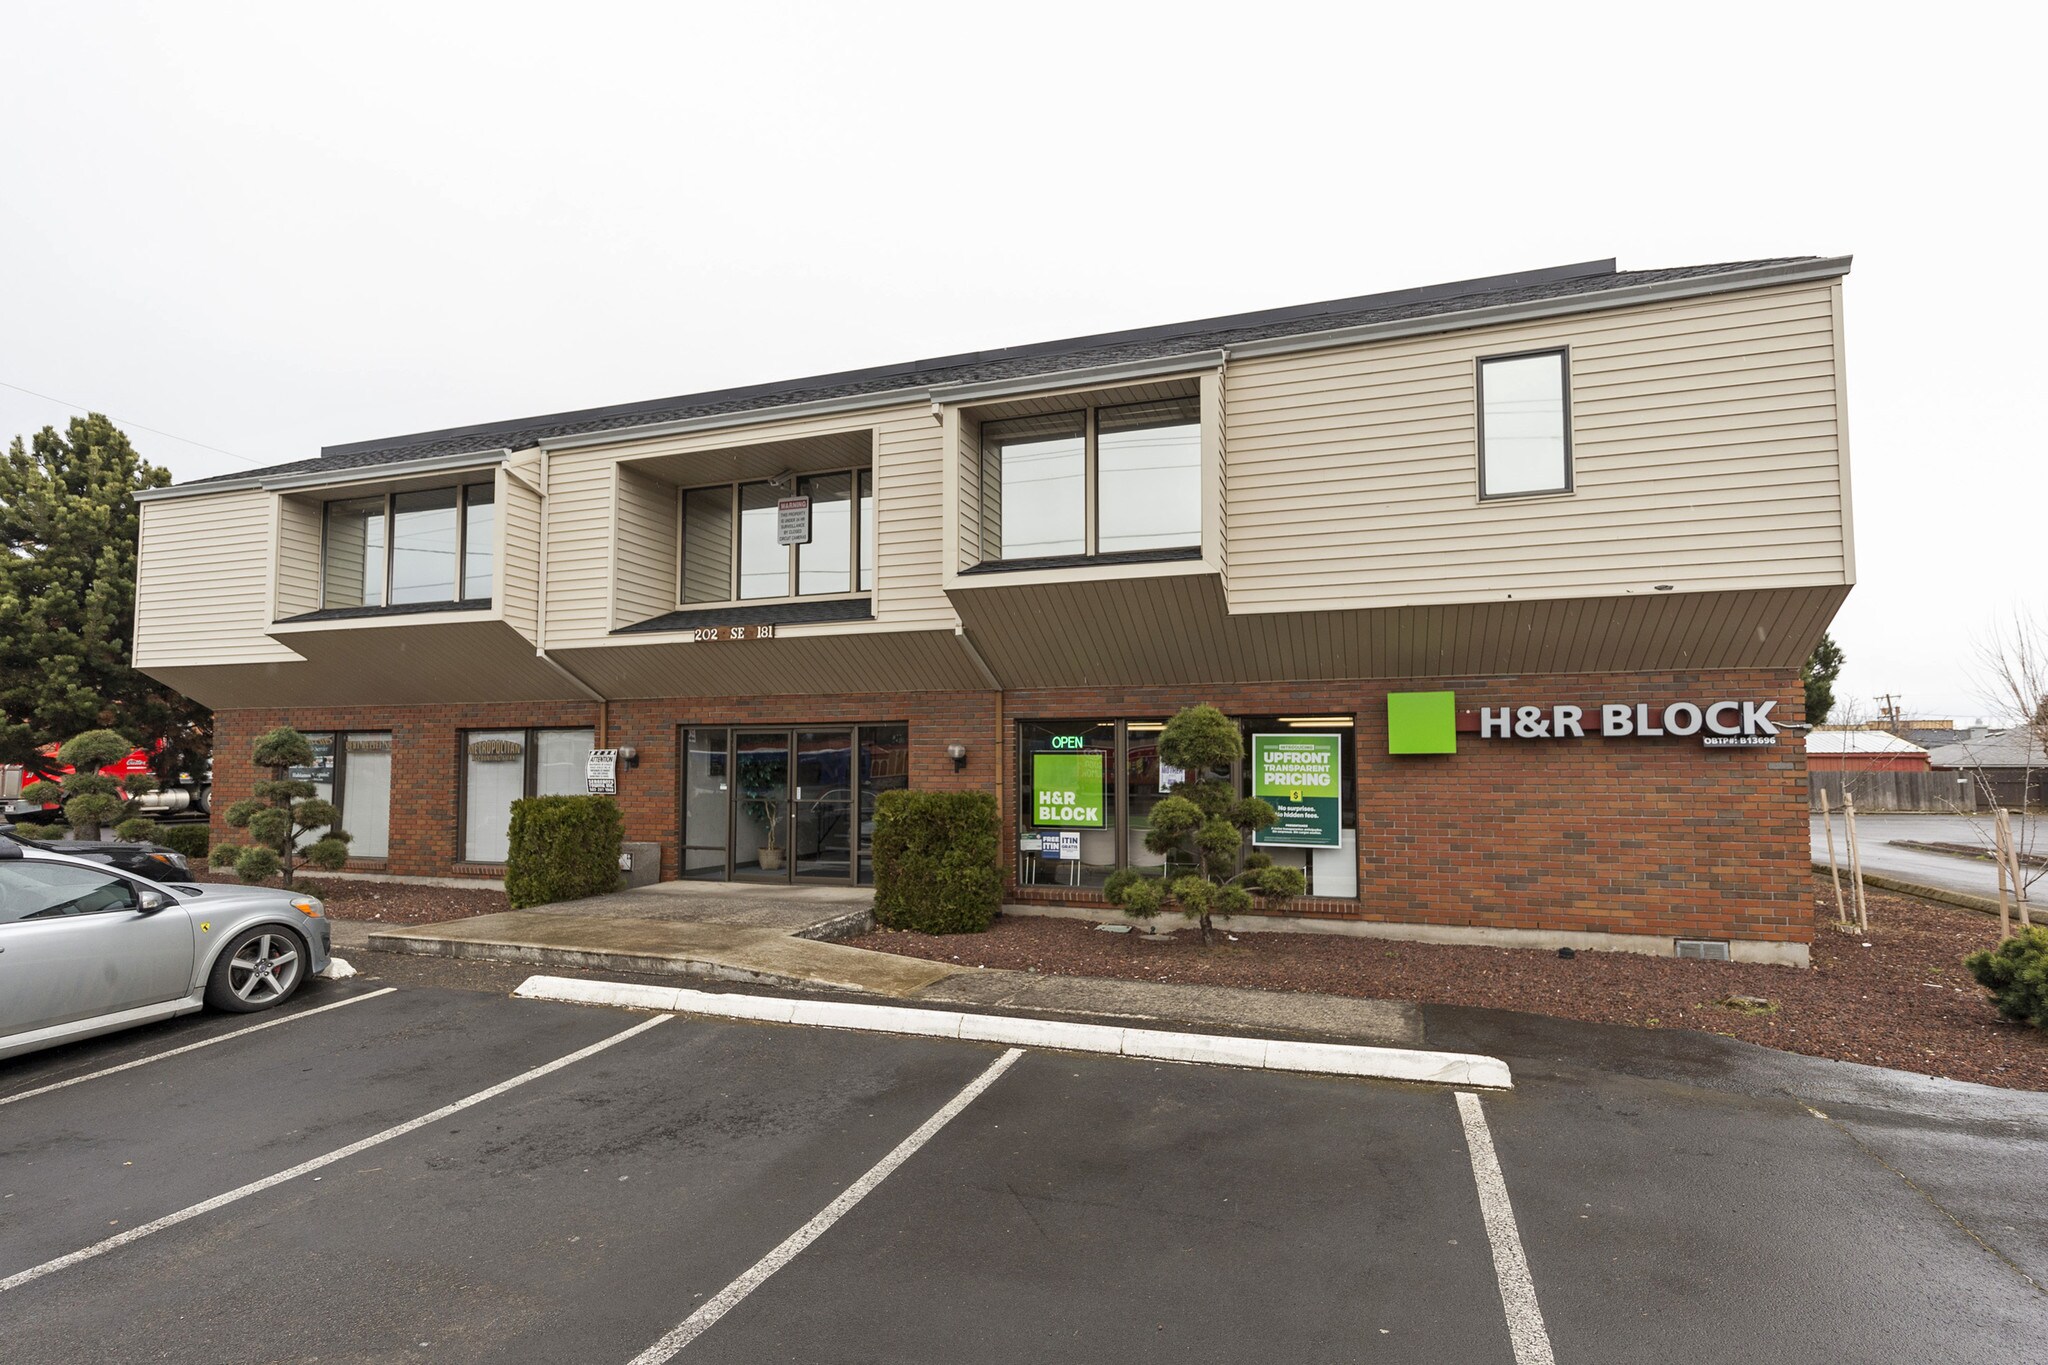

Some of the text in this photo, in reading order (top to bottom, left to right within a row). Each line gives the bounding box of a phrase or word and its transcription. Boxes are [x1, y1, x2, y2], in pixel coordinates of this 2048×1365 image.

[780, 501, 806, 509] WARNING
[695, 625, 773, 641] 202 SE 181
[1479, 699, 1781, 739] H&R BLOCK
[468, 740, 520, 754] METROPOLITAN
[1051, 735, 1084, 749] OPEN
[1703, 736, 1776, 745] OBTP#: B13696
[1263, 751, 1331, 764] UPFRONT
[1263, 764, 1331, 773] TRANSPARENT
[1264, 772, 1331, 786] PRICING
[1039, 790, 1076, 805] H&R
[1039, 806, 1098, 821] BLOCK
[1042, 842, 1060, 850] ITIN
